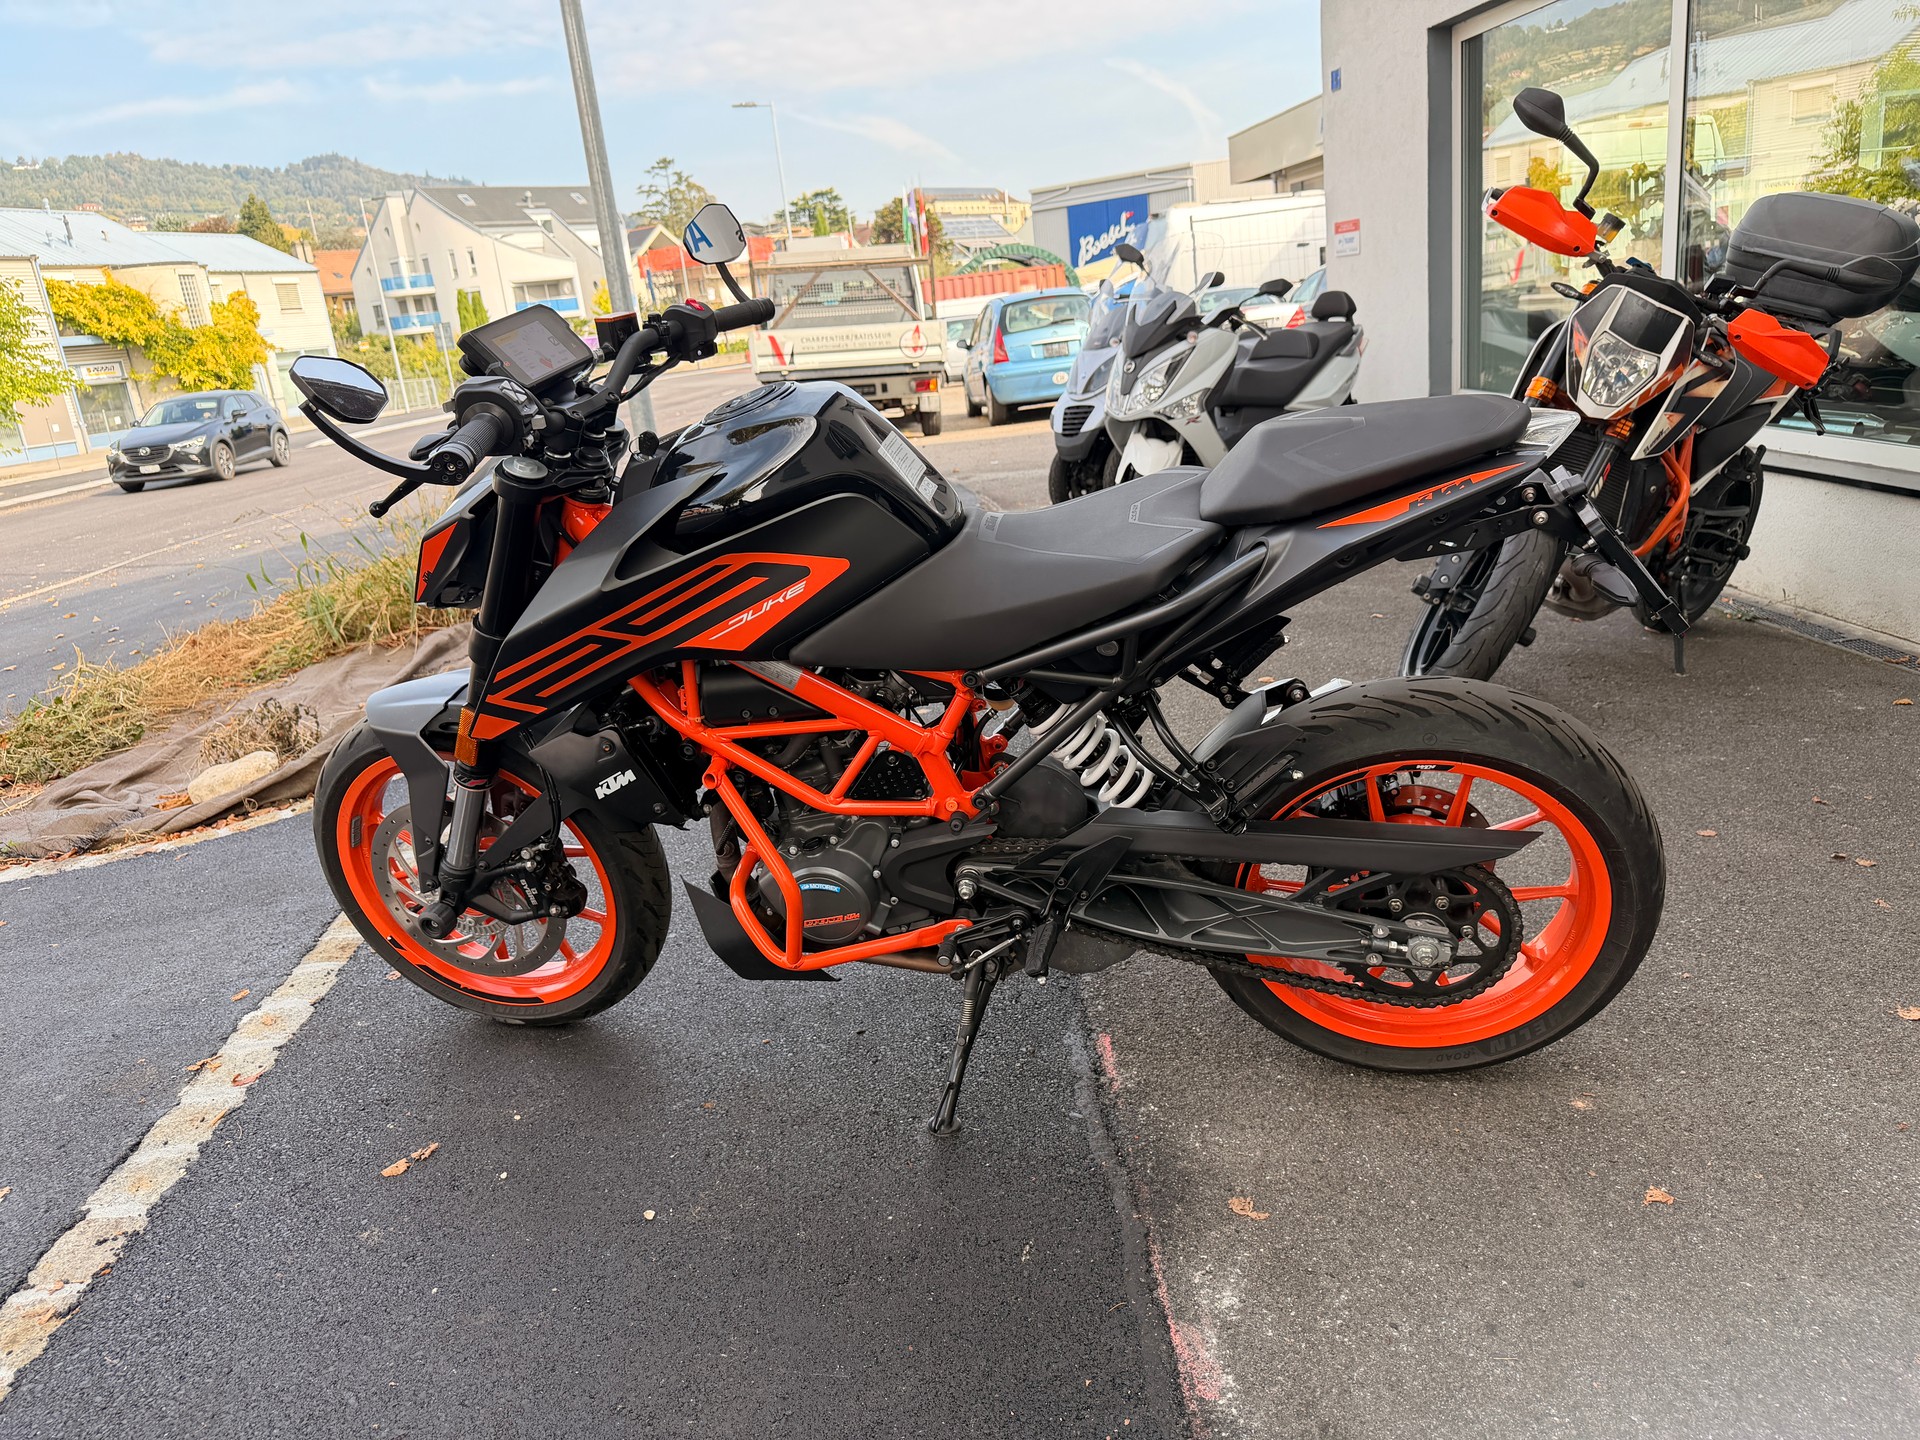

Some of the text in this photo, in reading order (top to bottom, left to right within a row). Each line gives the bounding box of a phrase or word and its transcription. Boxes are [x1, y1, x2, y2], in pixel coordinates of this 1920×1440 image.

[709, 580, 807, 641] DUKE
[594, 769, 637, 800] KTM
[1435, 1052, 1471, 1064] ROAD
